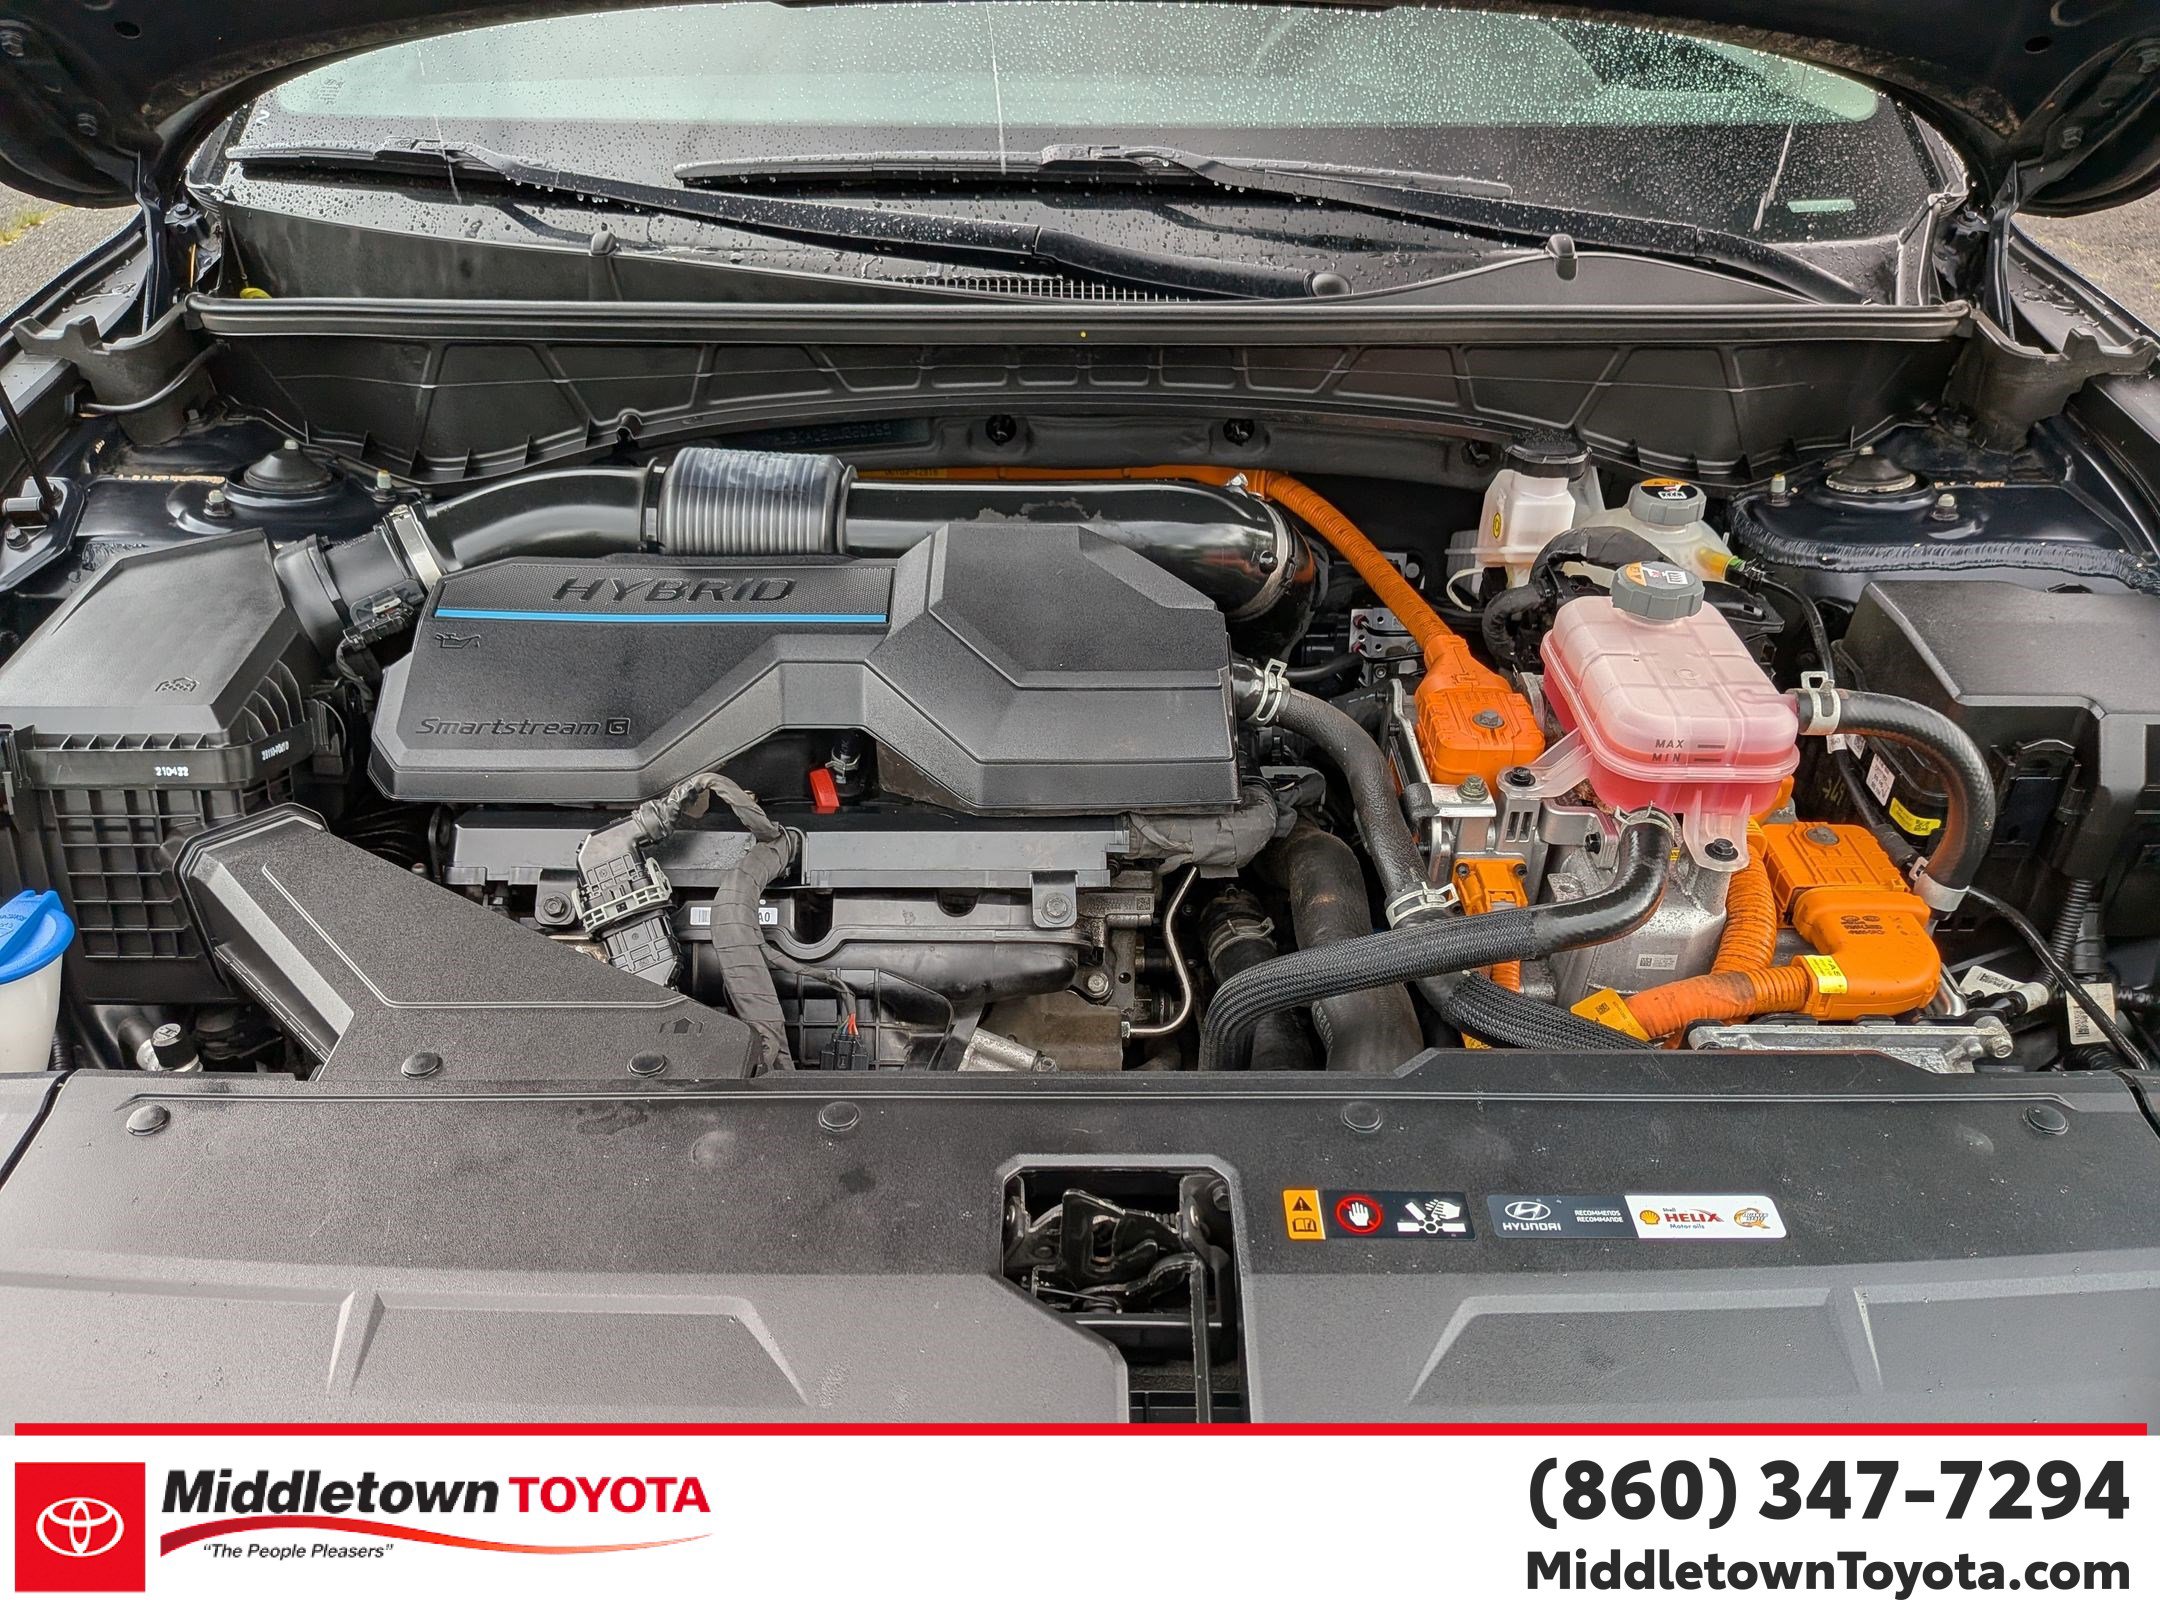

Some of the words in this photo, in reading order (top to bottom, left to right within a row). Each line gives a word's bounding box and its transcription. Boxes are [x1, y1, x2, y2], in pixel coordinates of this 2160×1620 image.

[551, 577, 797, 602] HYBRID
[415, 717, 600, 736] Smartstream
[1655, 738, 1685, 749] MAX
[1651, 752, 1681, 762] MIN
[1664, 1213, 1723, 1223] HELIX
[1502, 1222, 1562, 1231] HYUNDAI
